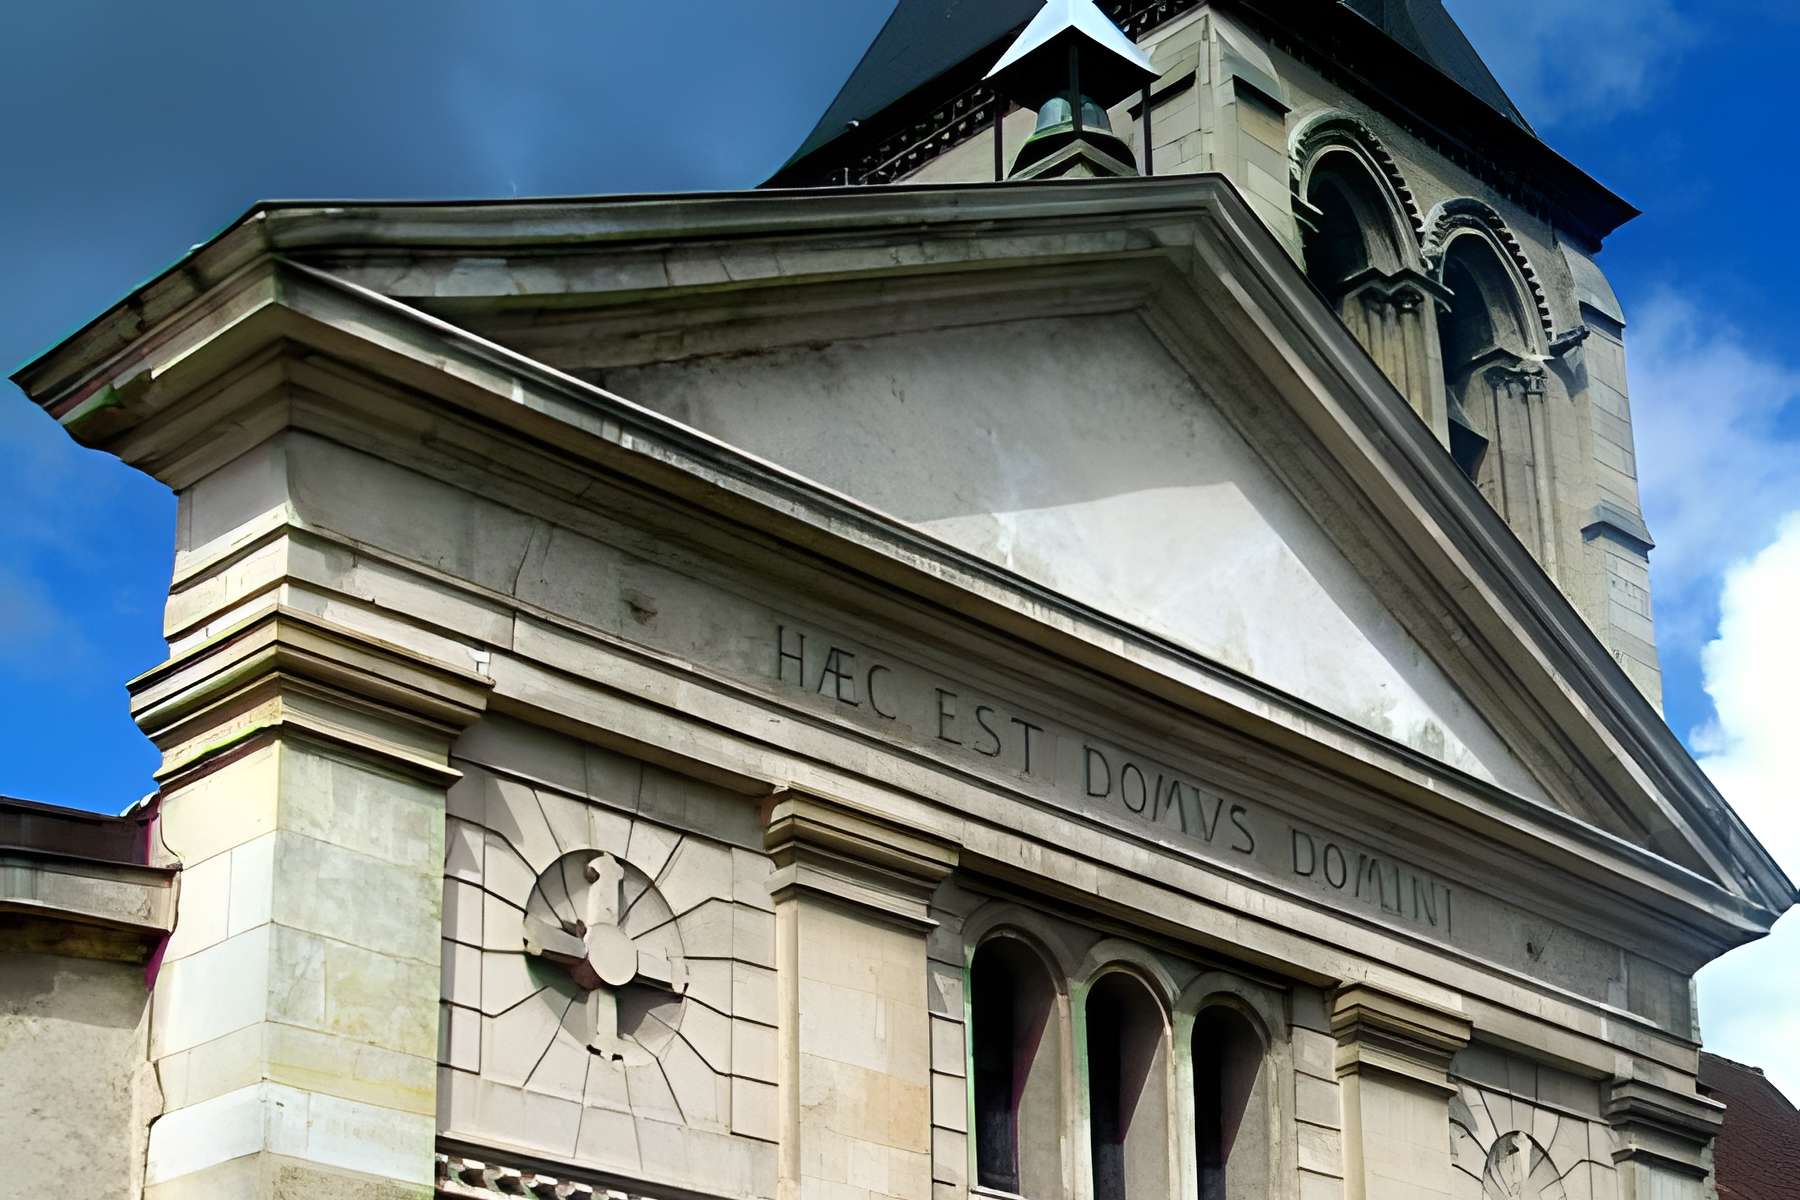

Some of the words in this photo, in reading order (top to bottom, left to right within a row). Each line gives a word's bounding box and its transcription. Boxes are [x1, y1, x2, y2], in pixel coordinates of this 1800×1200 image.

[936, 687, 1044, 774] EST
[1083, 744, 1255, 855] DOMVS
[1290, 827, 1453, 938] DOMINI
